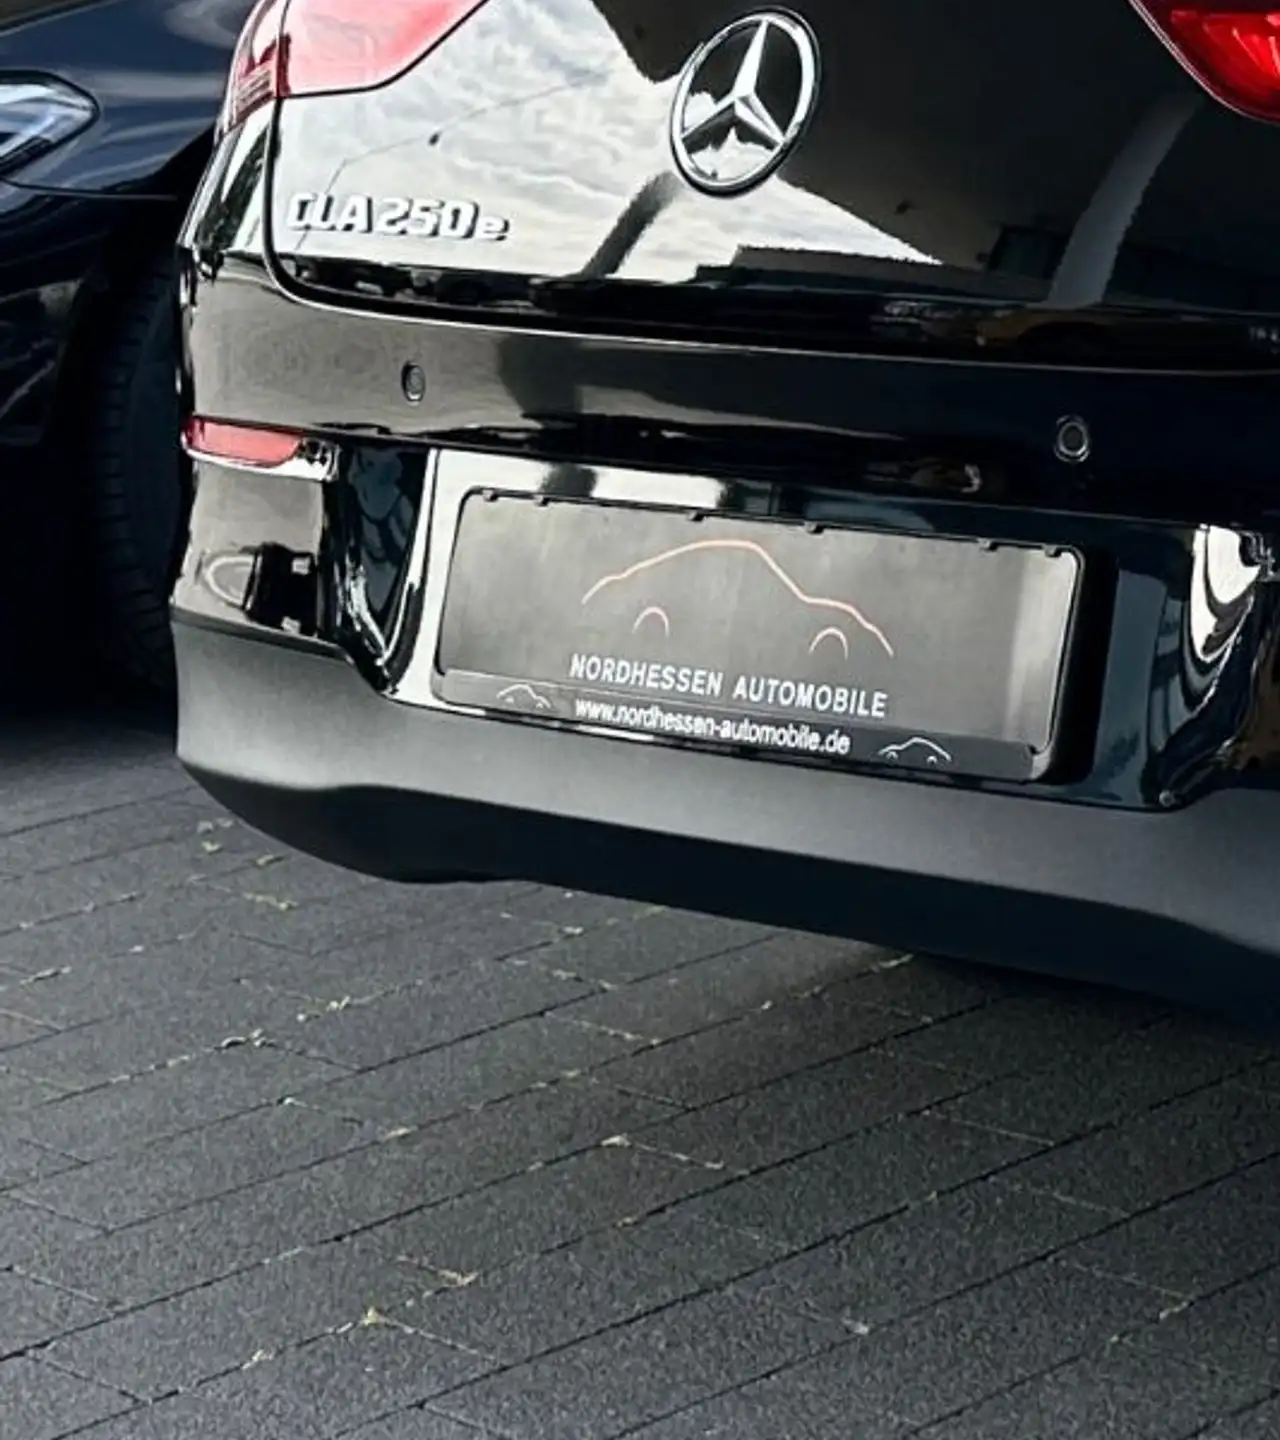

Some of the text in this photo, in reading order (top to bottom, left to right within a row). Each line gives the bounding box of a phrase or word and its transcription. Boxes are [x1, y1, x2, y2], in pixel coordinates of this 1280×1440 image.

[570, 653, 887, 718] NORDHESSEN AUTOMOBILE
[575, 698, 850, 754] www.nordhessen-automobile.de
